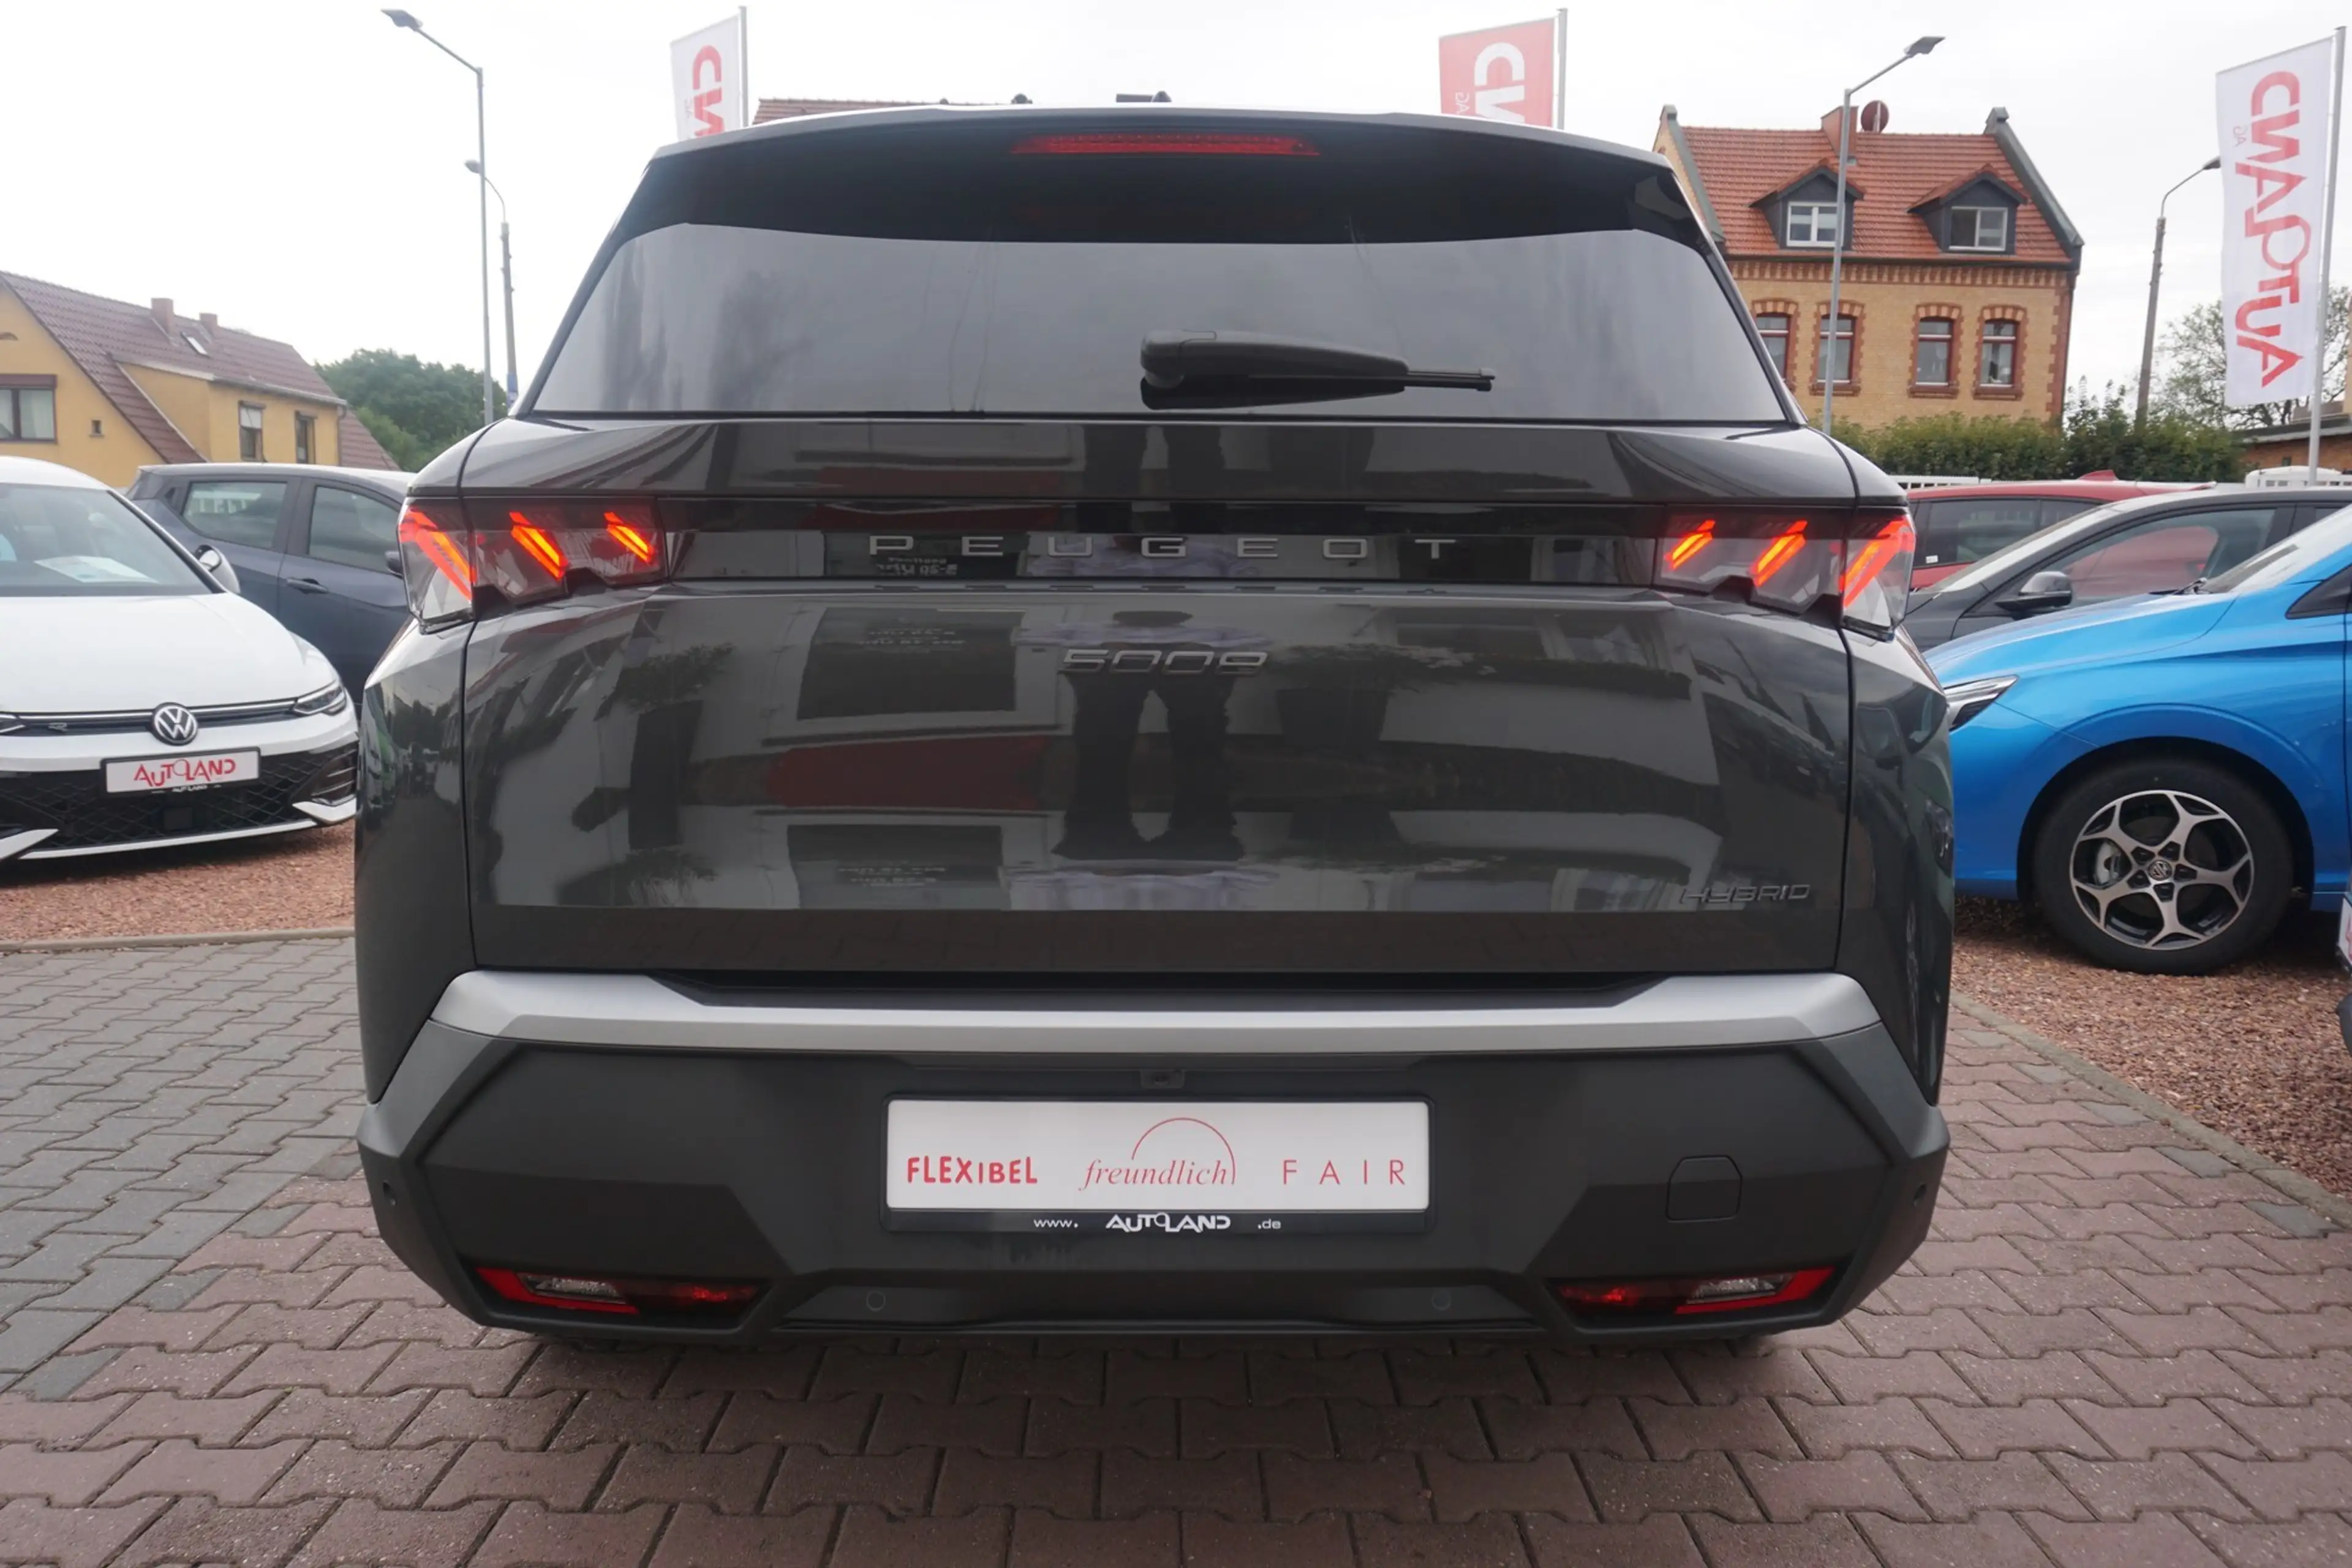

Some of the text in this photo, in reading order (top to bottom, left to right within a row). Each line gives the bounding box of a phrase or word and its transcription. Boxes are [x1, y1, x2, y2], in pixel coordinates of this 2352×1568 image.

[869, 535, 1457, 560] PEUGEOT
[1058, 649, 1269, 676] 5008
[133, 758, 236, 787] AUTOLAND
[1679, 884, 1811, 905] HYBRID
[907, 1155, 1406, 1192] FLEXIBEL freundlich FAIR
[1033, 1212, 1282, 1233] www. AUTOLAND .de
